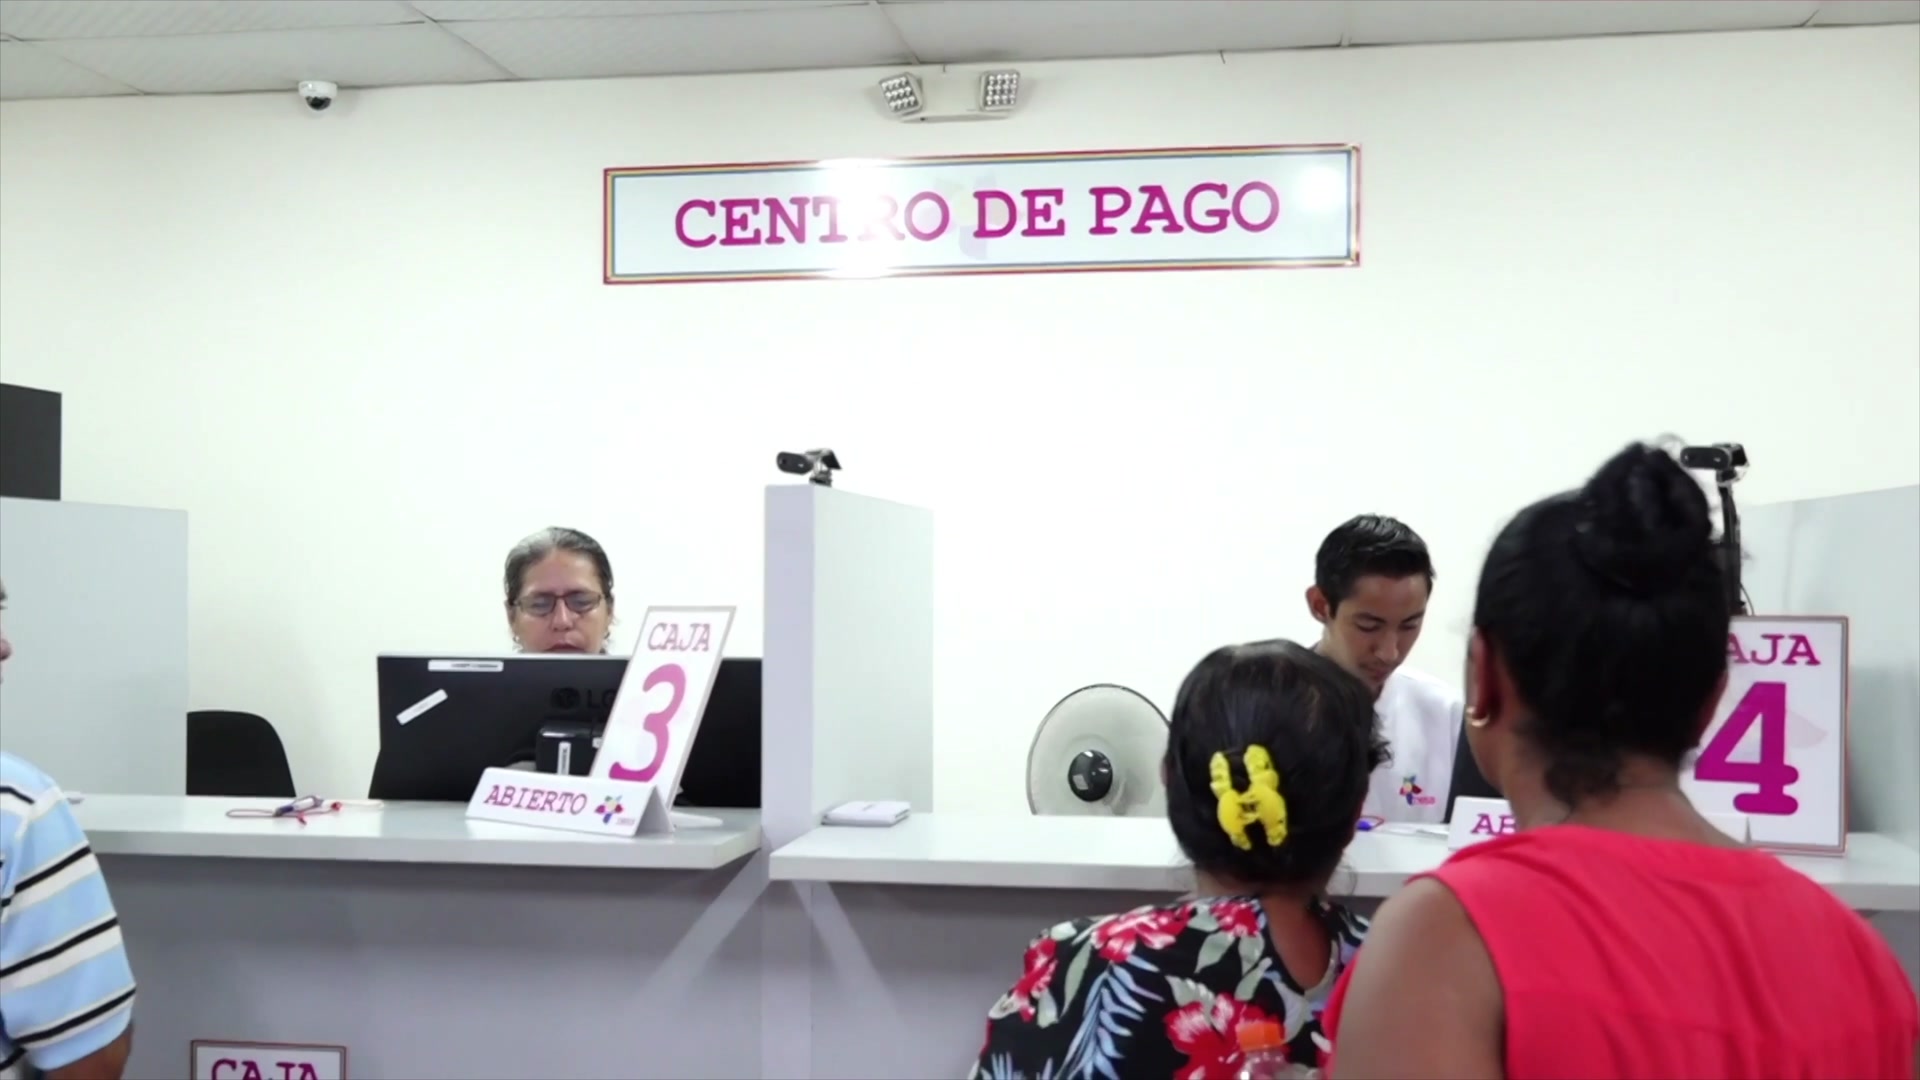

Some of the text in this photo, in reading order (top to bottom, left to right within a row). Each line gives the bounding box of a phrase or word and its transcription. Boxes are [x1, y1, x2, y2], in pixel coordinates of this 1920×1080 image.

[675, 180, 1280, 249] CENTRO DE PAGO
[647, 622, 711, 652] CAJA
[1726, 632, 1821, 666] AJA
[608, 662, 687, 783] 3
[1694, 681, 1800, 816] 4
[483, 784, 588, 815] ABIERTO
